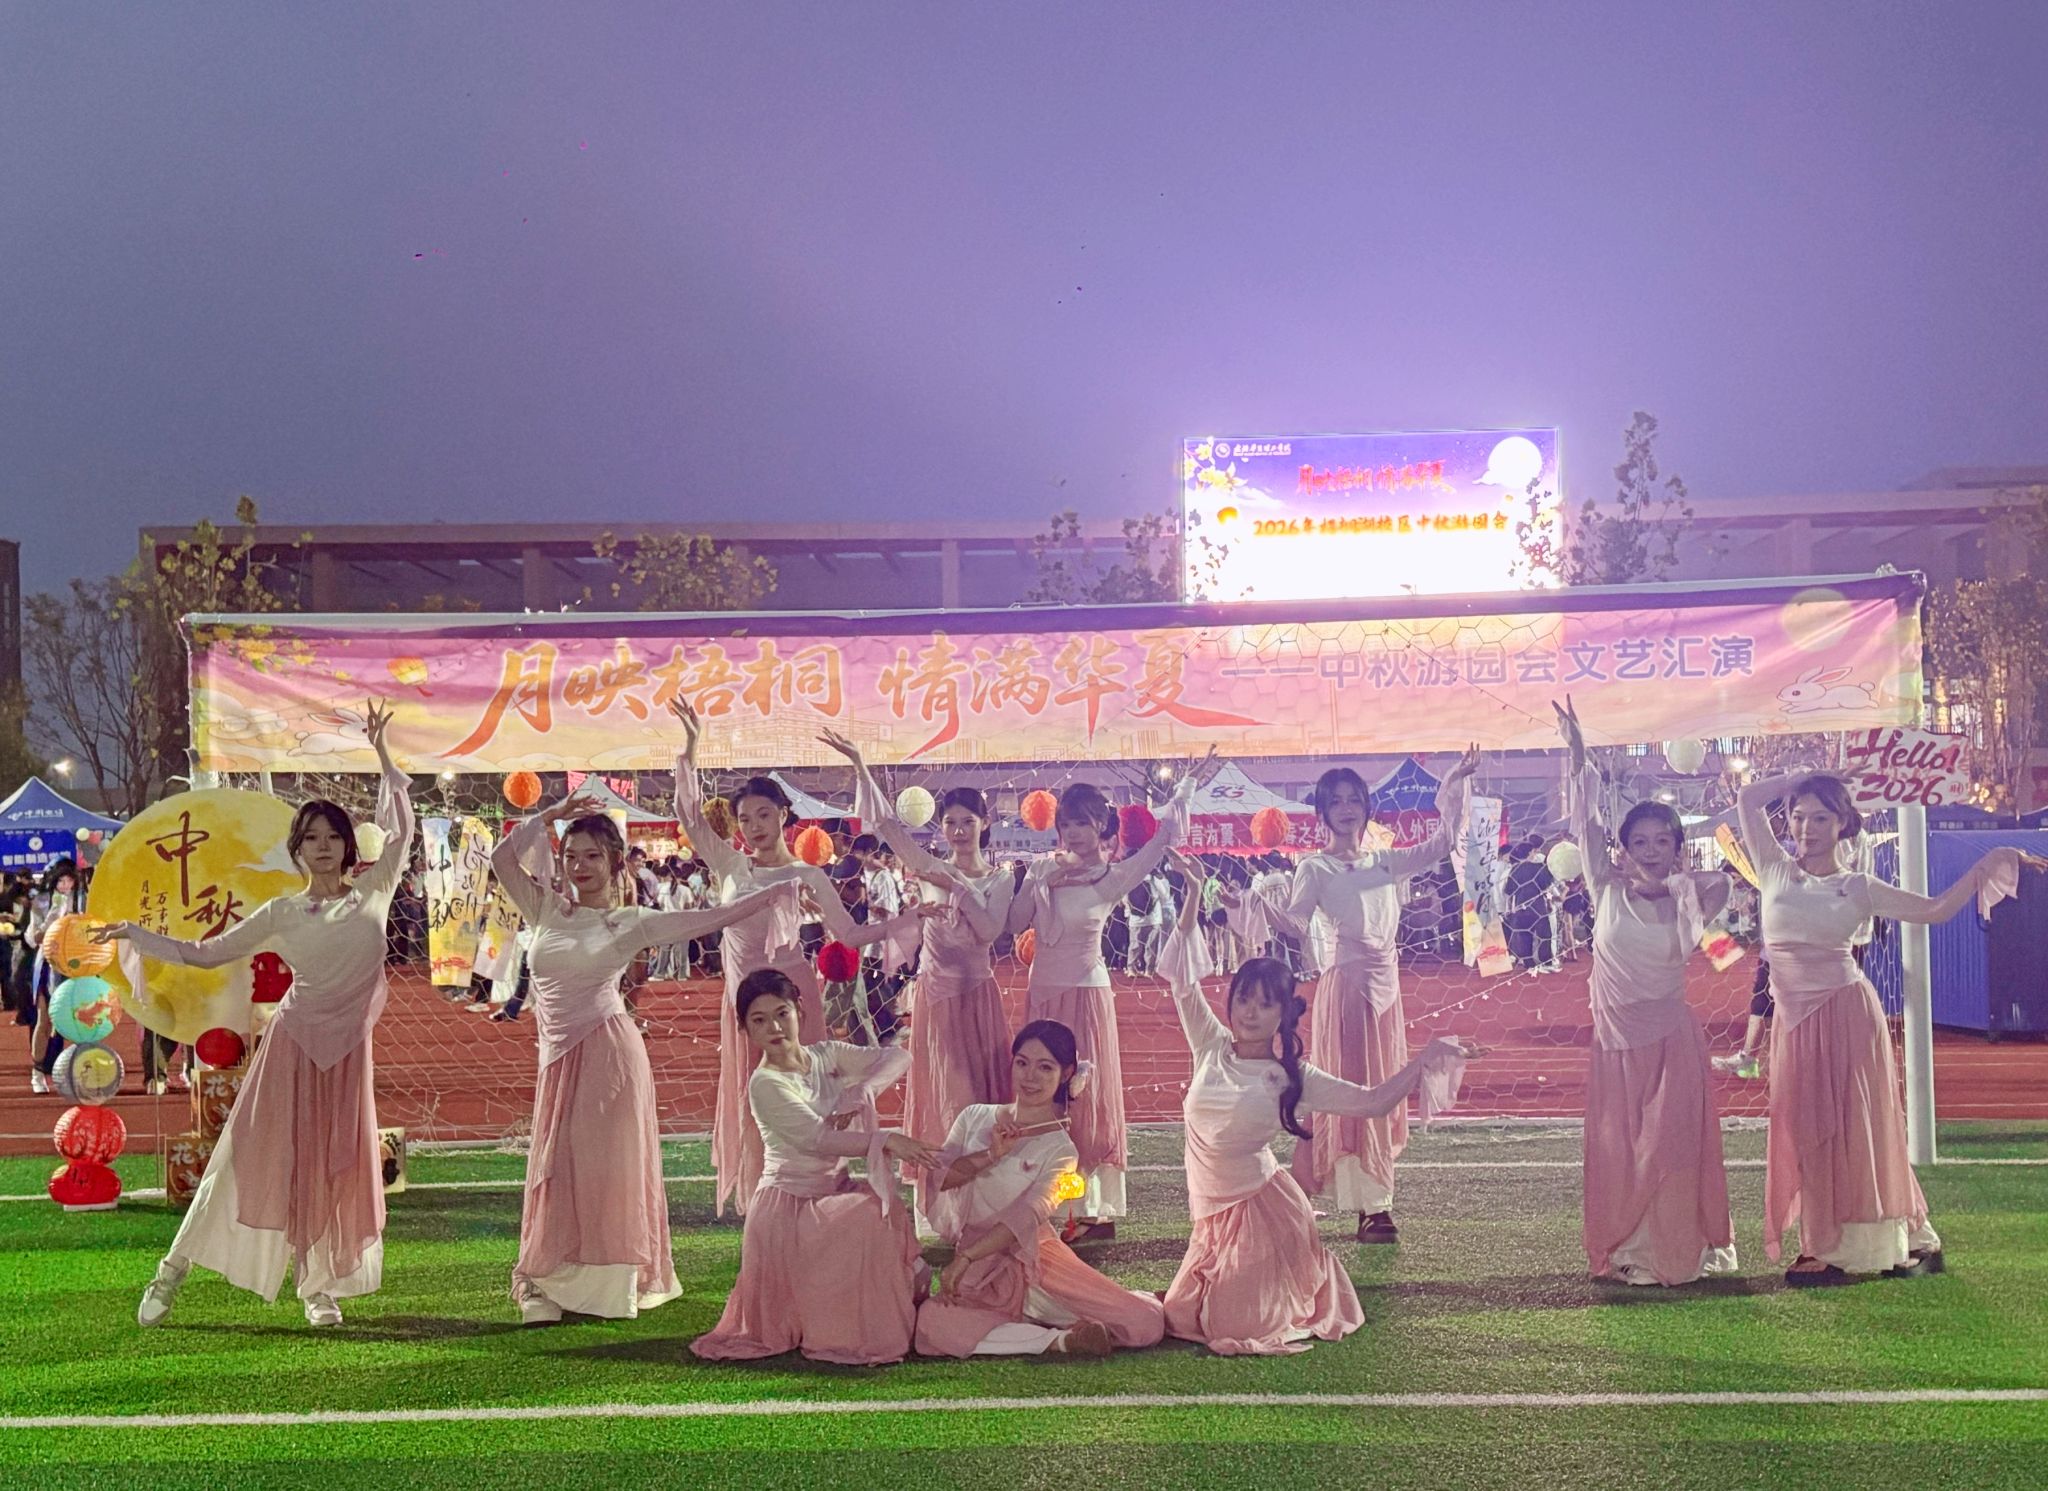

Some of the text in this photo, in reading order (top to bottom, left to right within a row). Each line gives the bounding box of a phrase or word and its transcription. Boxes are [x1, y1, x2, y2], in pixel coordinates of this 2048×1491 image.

[439, 629, 1277, 762] 月映梧桐 情满华夏
[1847, 728, 1960, 773] Hello!
[1856, 775, 1945, 806] 2026
[146, 811, 244, 941] 中秋
